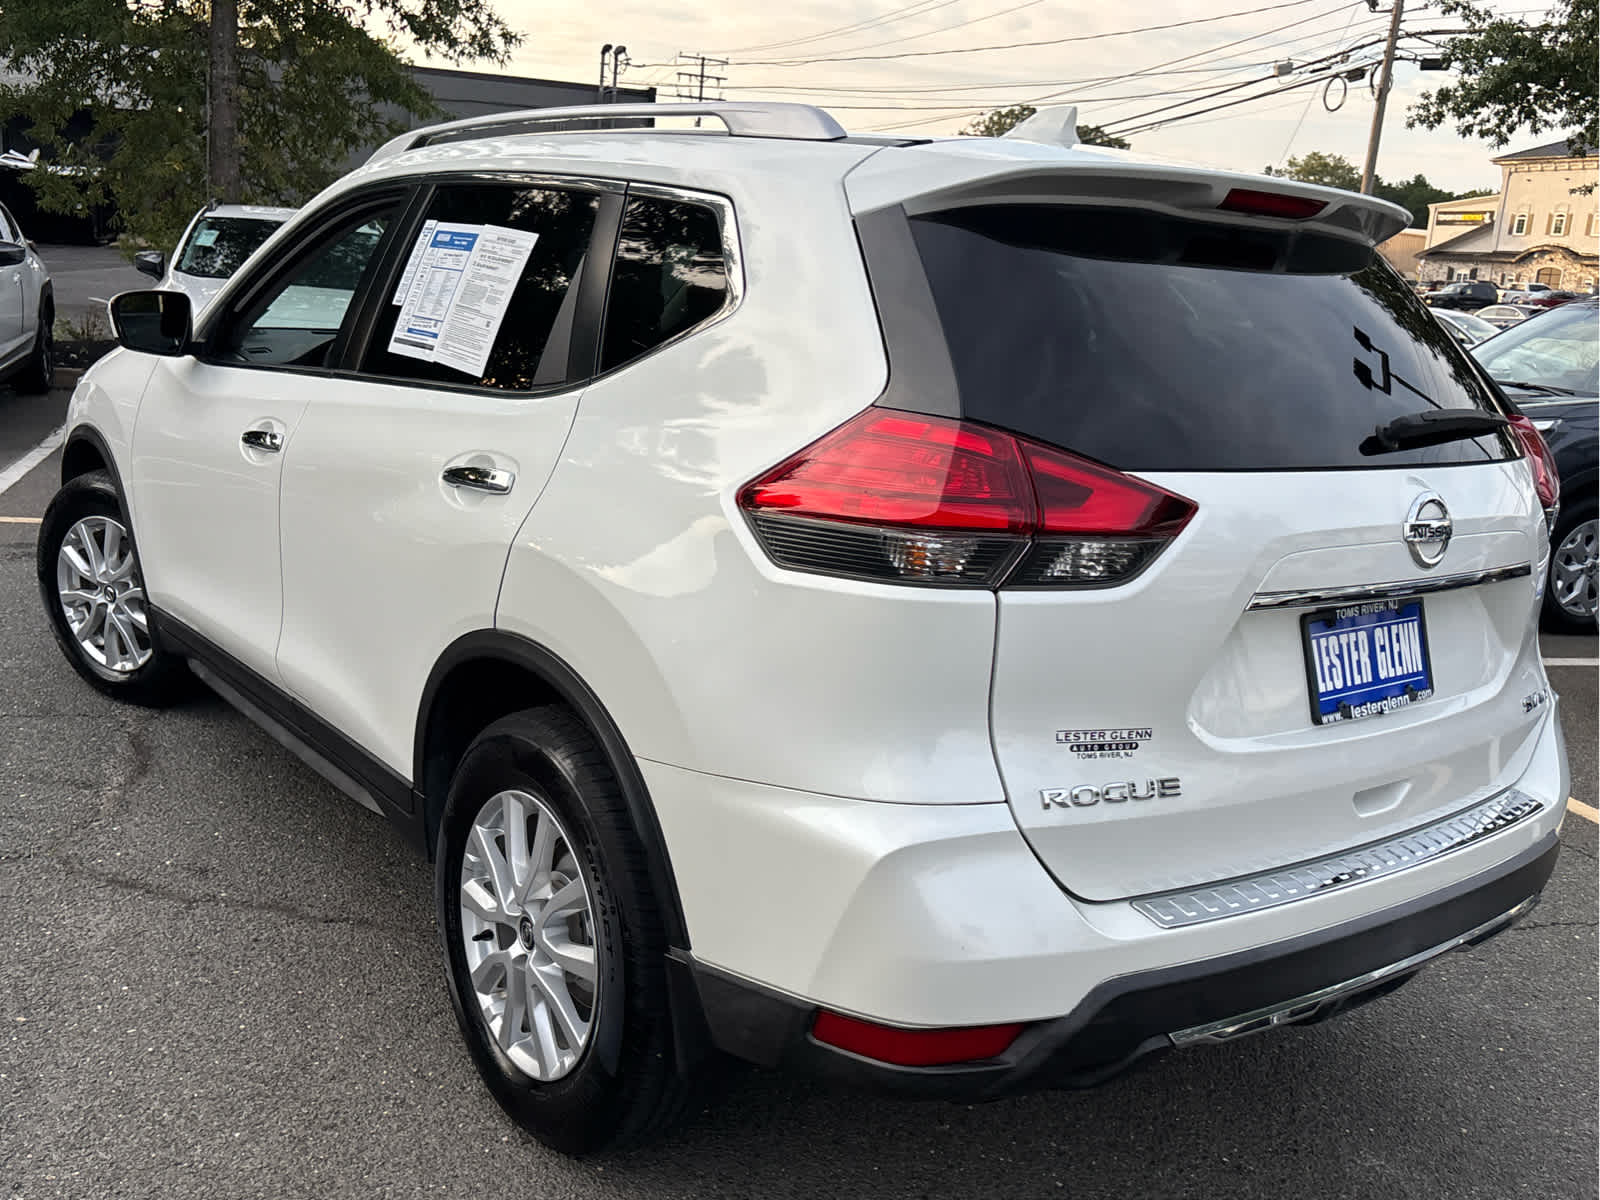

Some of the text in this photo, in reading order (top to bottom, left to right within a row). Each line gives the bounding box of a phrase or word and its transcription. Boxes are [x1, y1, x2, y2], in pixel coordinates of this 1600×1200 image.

[1336, 606, 1360, 620] TOMS
[1388, 599, 1398, 610] NJ
[1312, 621, 1423, 693] LESTER GLENN
[1351, 694, 1410, 718] lesterglenn
[1056, 730, 1152, 741] LESTER GLENN
[1072, 742, 1137, 752] AUTO GROUP
[1077, 752, 1098, 760] TOMS
[1039, 777, 1182, 810] ROGUE
